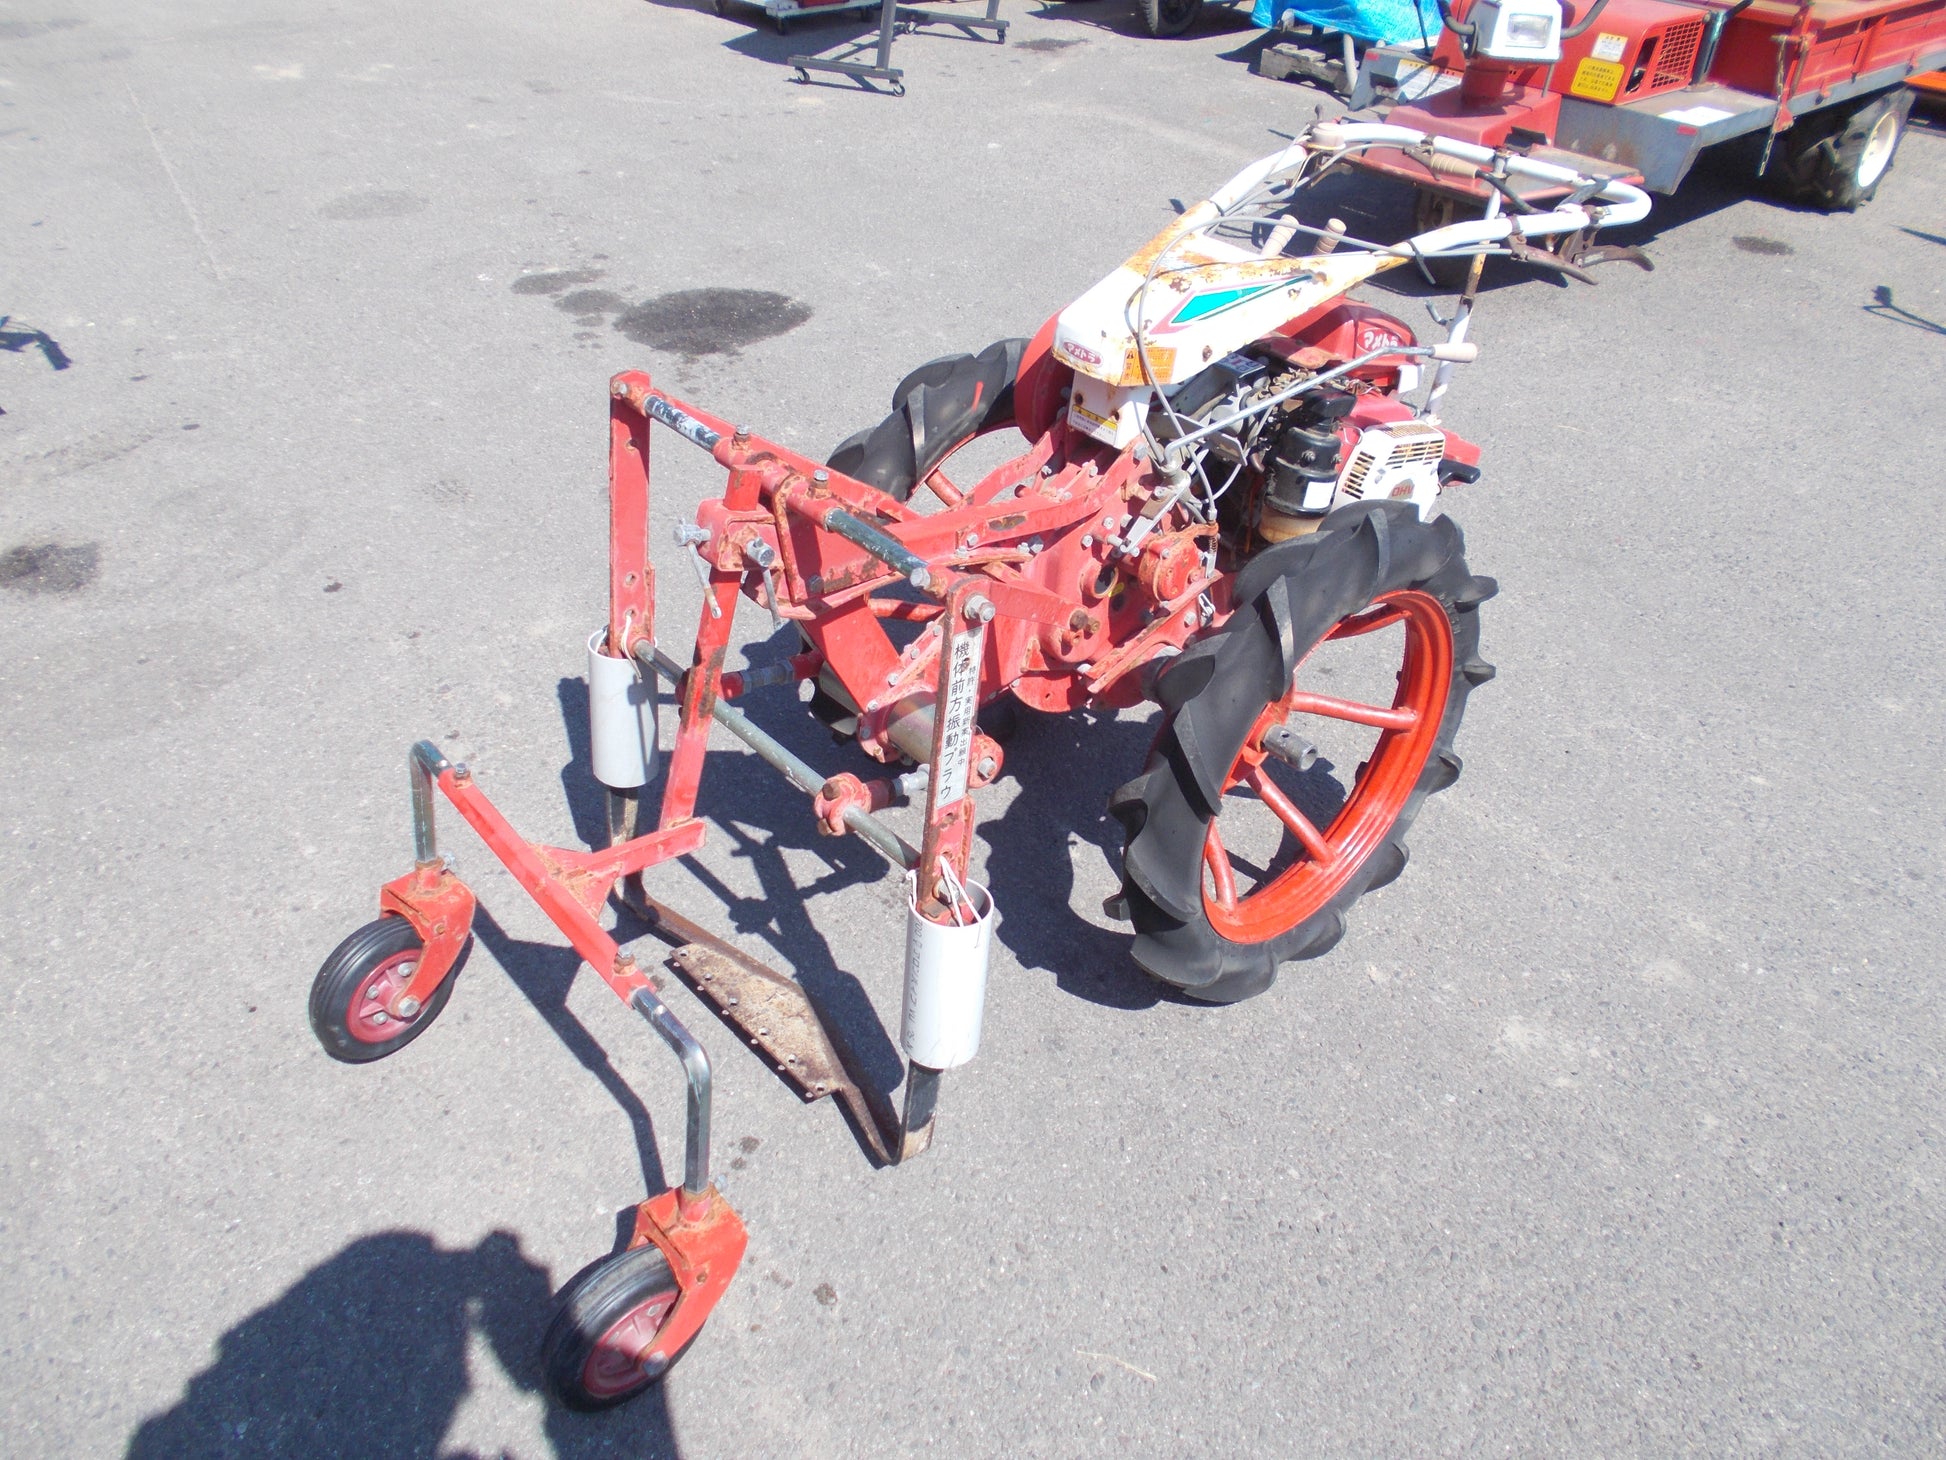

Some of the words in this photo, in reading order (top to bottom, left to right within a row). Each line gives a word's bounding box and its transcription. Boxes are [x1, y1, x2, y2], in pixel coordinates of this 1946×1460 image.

[1066, 342, 1097, 363] マメトラ
[940, 641, 970, 800] 機体前方振動プラウ
